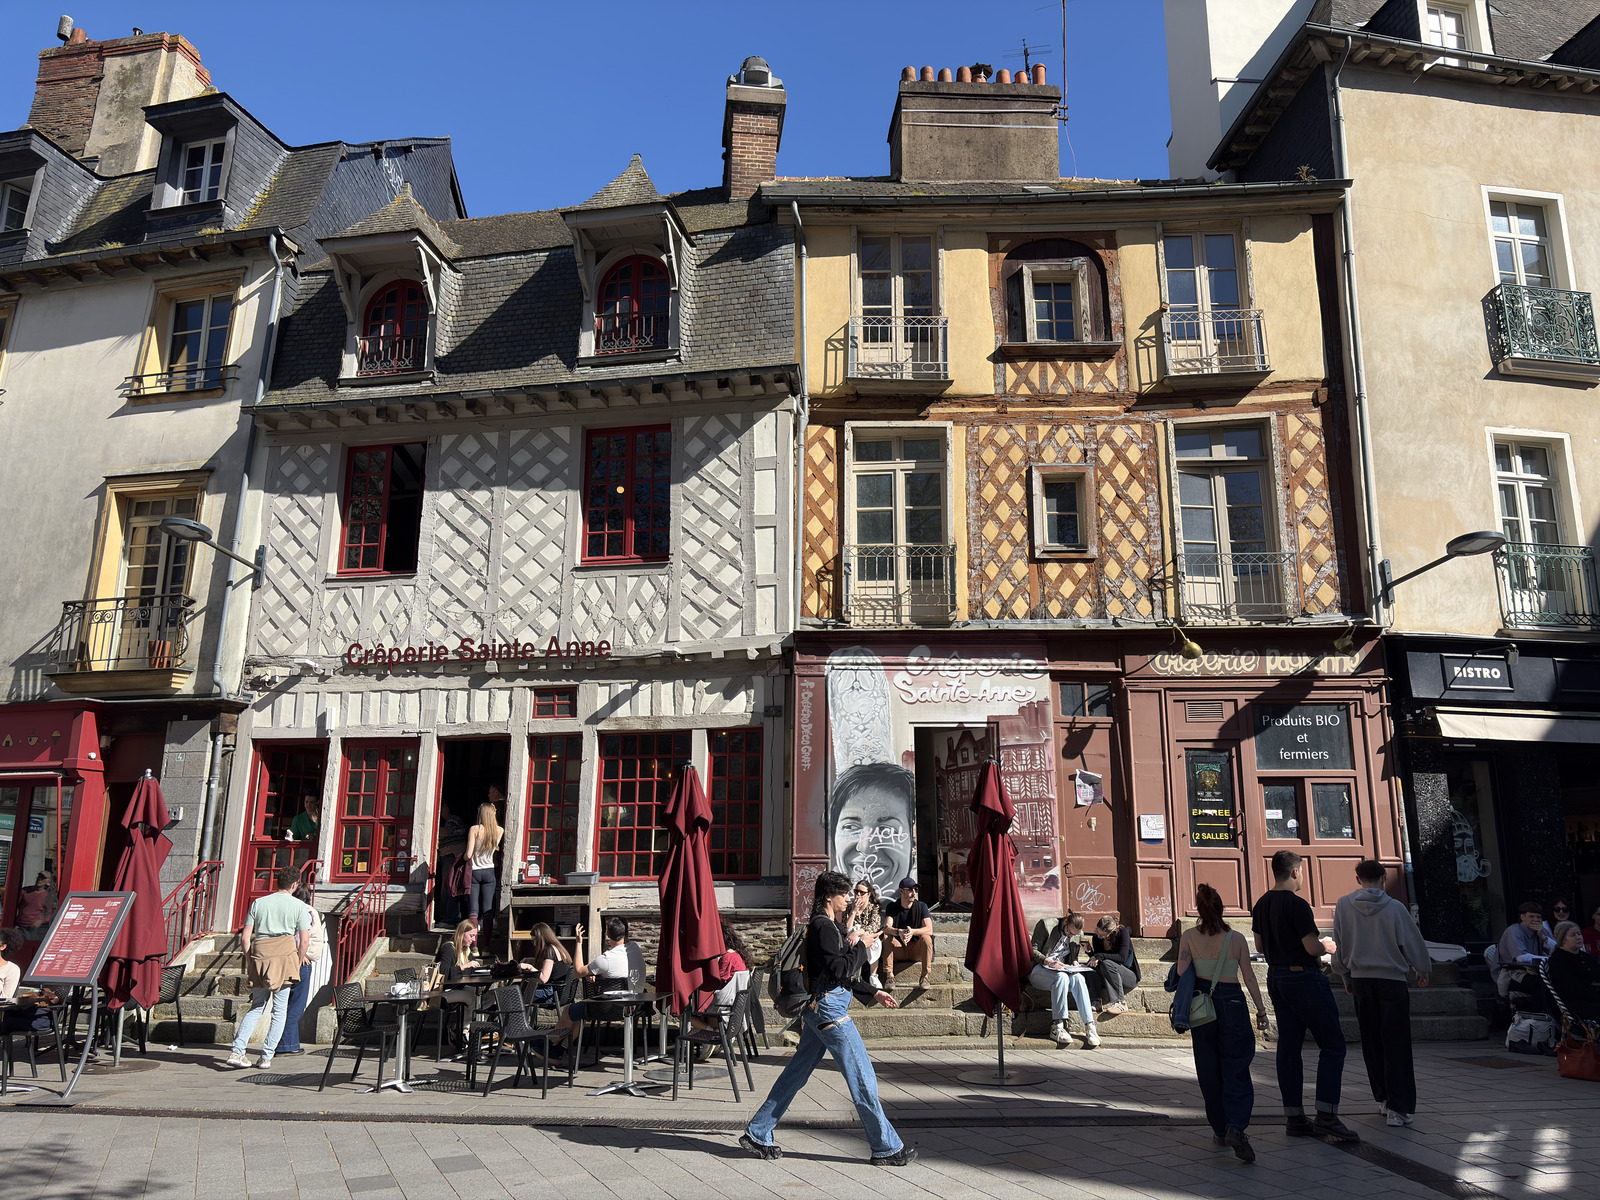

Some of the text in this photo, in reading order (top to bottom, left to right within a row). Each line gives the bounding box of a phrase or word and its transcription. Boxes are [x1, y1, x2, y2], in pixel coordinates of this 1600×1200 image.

[348, 636, 611, 670] Crêperie Sainte Anne
[906, 645, 1048, 684] Crêperie
[1453, 667, 1500, 679] BISTRO
[893, 672, 1037, 704] Sainte-Anne
[1262, 714, 1341, 727] Produits BIO
[1296, 732, 1309, 743] et
[1279, 747, 1329, 760] fermiers
